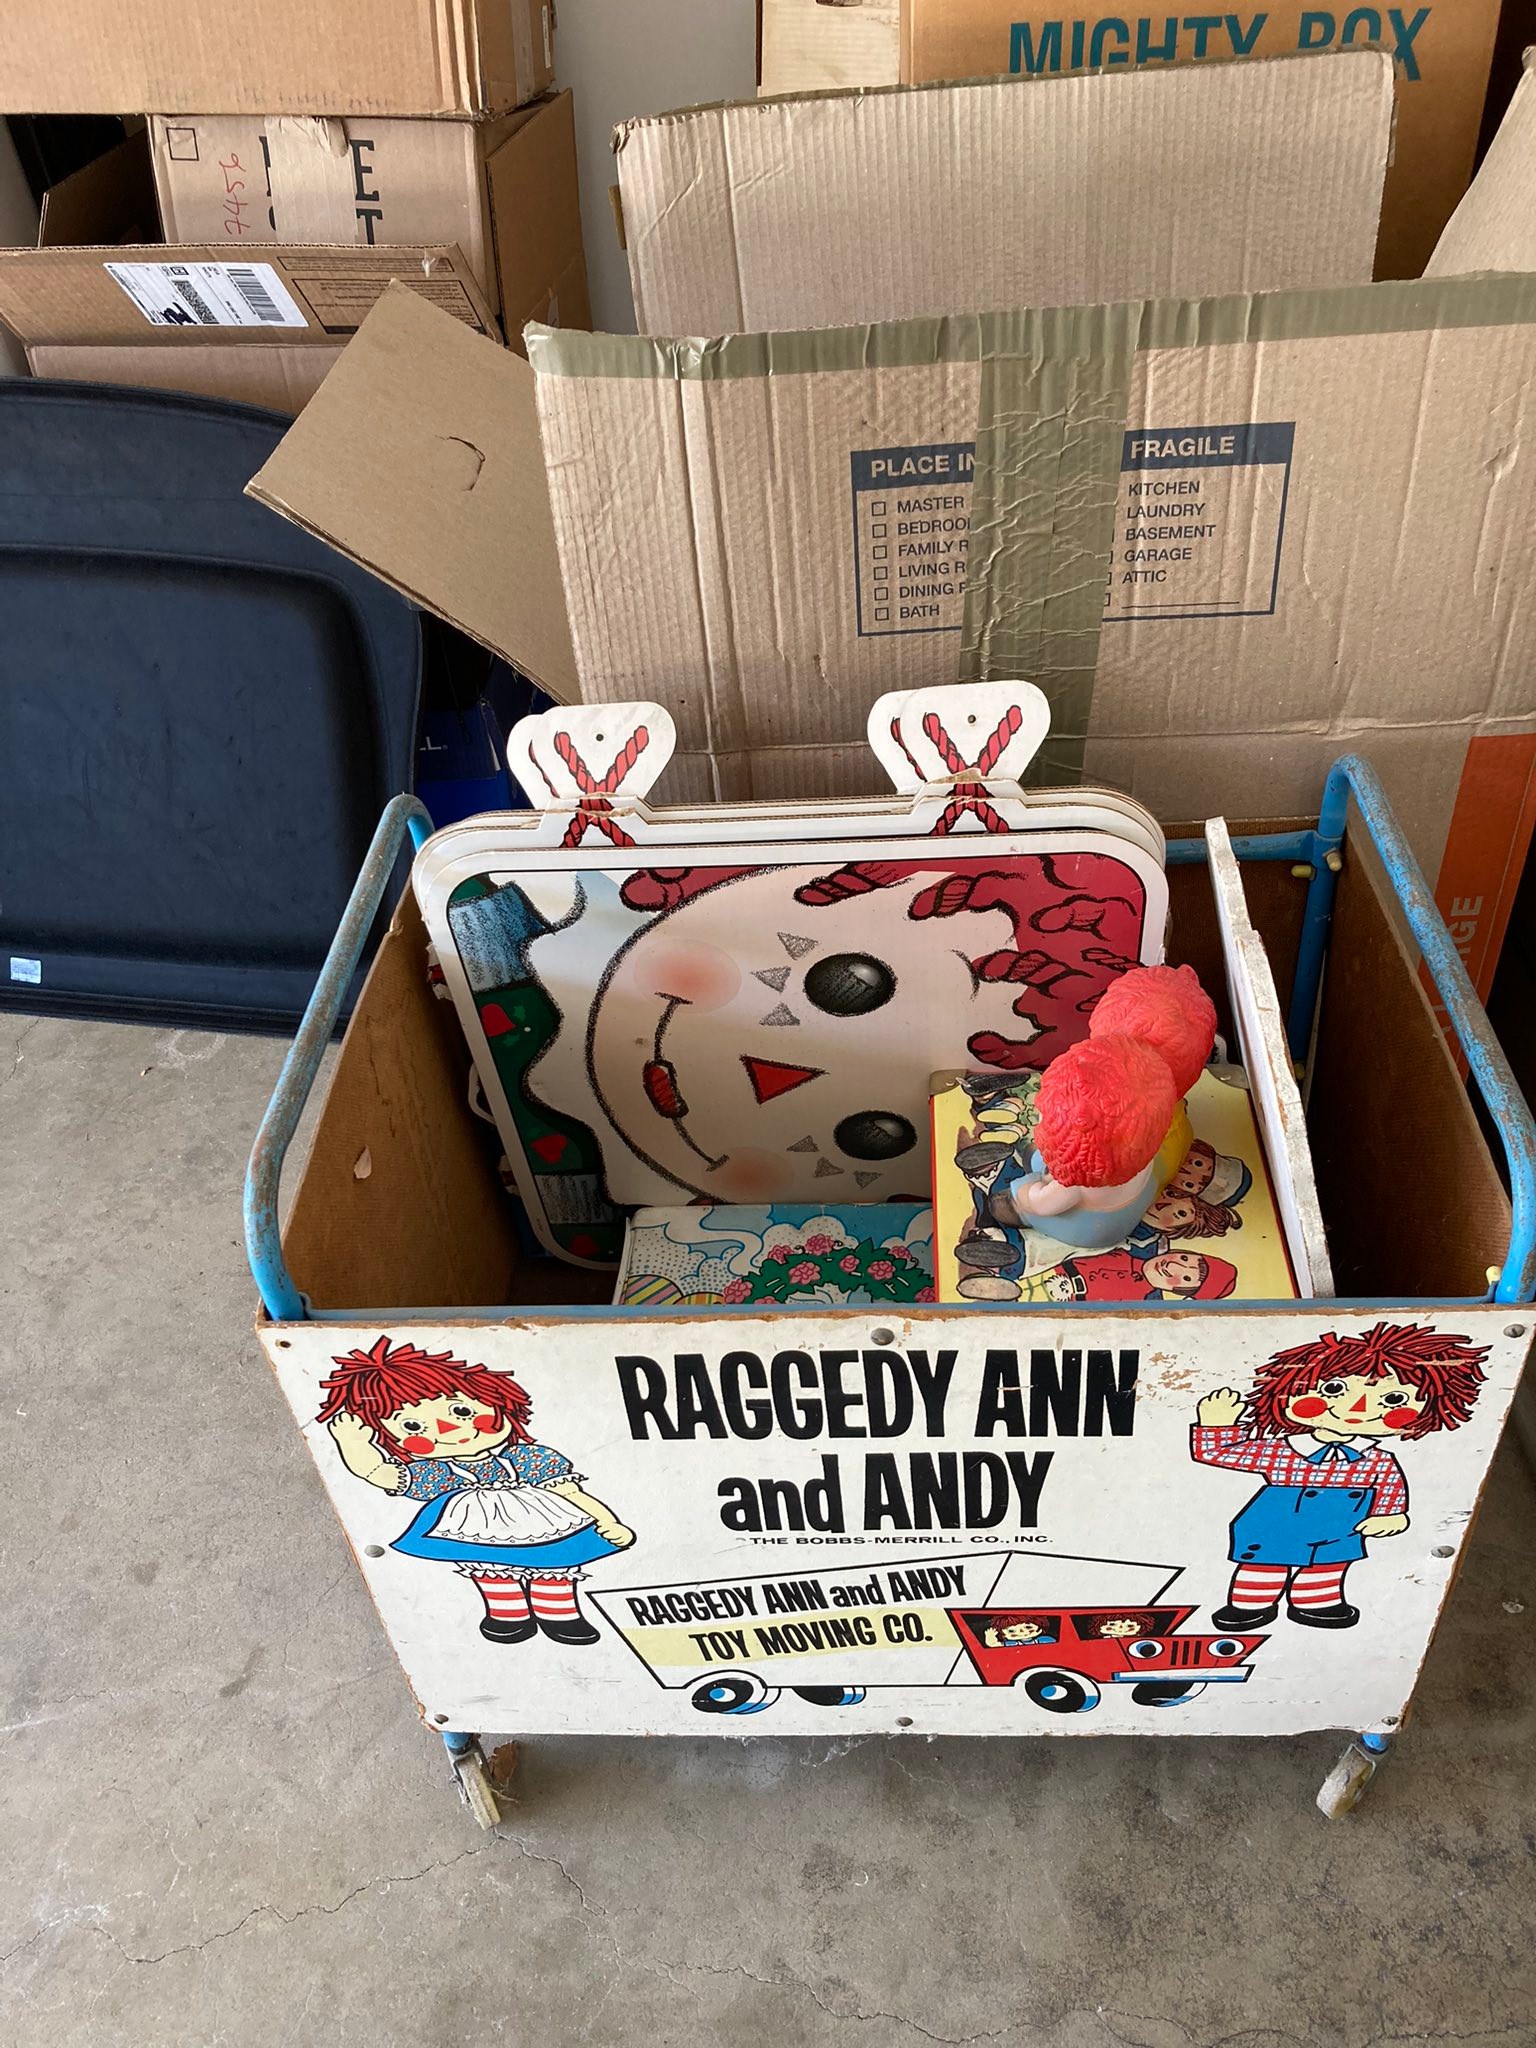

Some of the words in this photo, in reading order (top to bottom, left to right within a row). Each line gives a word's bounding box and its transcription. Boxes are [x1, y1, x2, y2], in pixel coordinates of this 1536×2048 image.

[1010, 13, 1268, 74] MIGHTY
[1130, 435, 1235, 459] FRAGILE
[871, 454, 950, 478] PLACE
[1128, 480, 1200, 497] KITCHEN
[897, 496, 965, 514] MASTER
[1126, 502, 1206, 519] LAUNDRY
[897, 517, 970, 536] BEDROO
[1125, 524, 1217, 541] BASEMENT
[898, 540, 954, 557] FAMILY
[1124, 547, 1193, 563] GARAGE
[898, 562, 950, 578] LIVING
[1122, 569, 1168, 585] ATTIC
[899, 582, 955, 599] DINING
[899, 604, 941, 619] BATH
[614, 1349, 959, 1441] RAGGEDY
[974, 1349, 1141, 1438] ANN
[717, 1453, 845, 1534] and
[863, 1451, 1056, 1531] ANDY
[749, 1536, 789, 1546] THE
[795, 1535, 963, 1545] BOBBS-MERRILL
[625, 1586, 757, 1626] RAGGEDY
[761, 1579, 829, 1615] ANN
[828, 1573, 883, 1609] and
[887, 1564, 967, 1602] ANDY
[688, 1629, 757, 1662] TOY
[752, 1615, 877, 1656] MOVING
[882, 1612, 934, 1644] CO.
